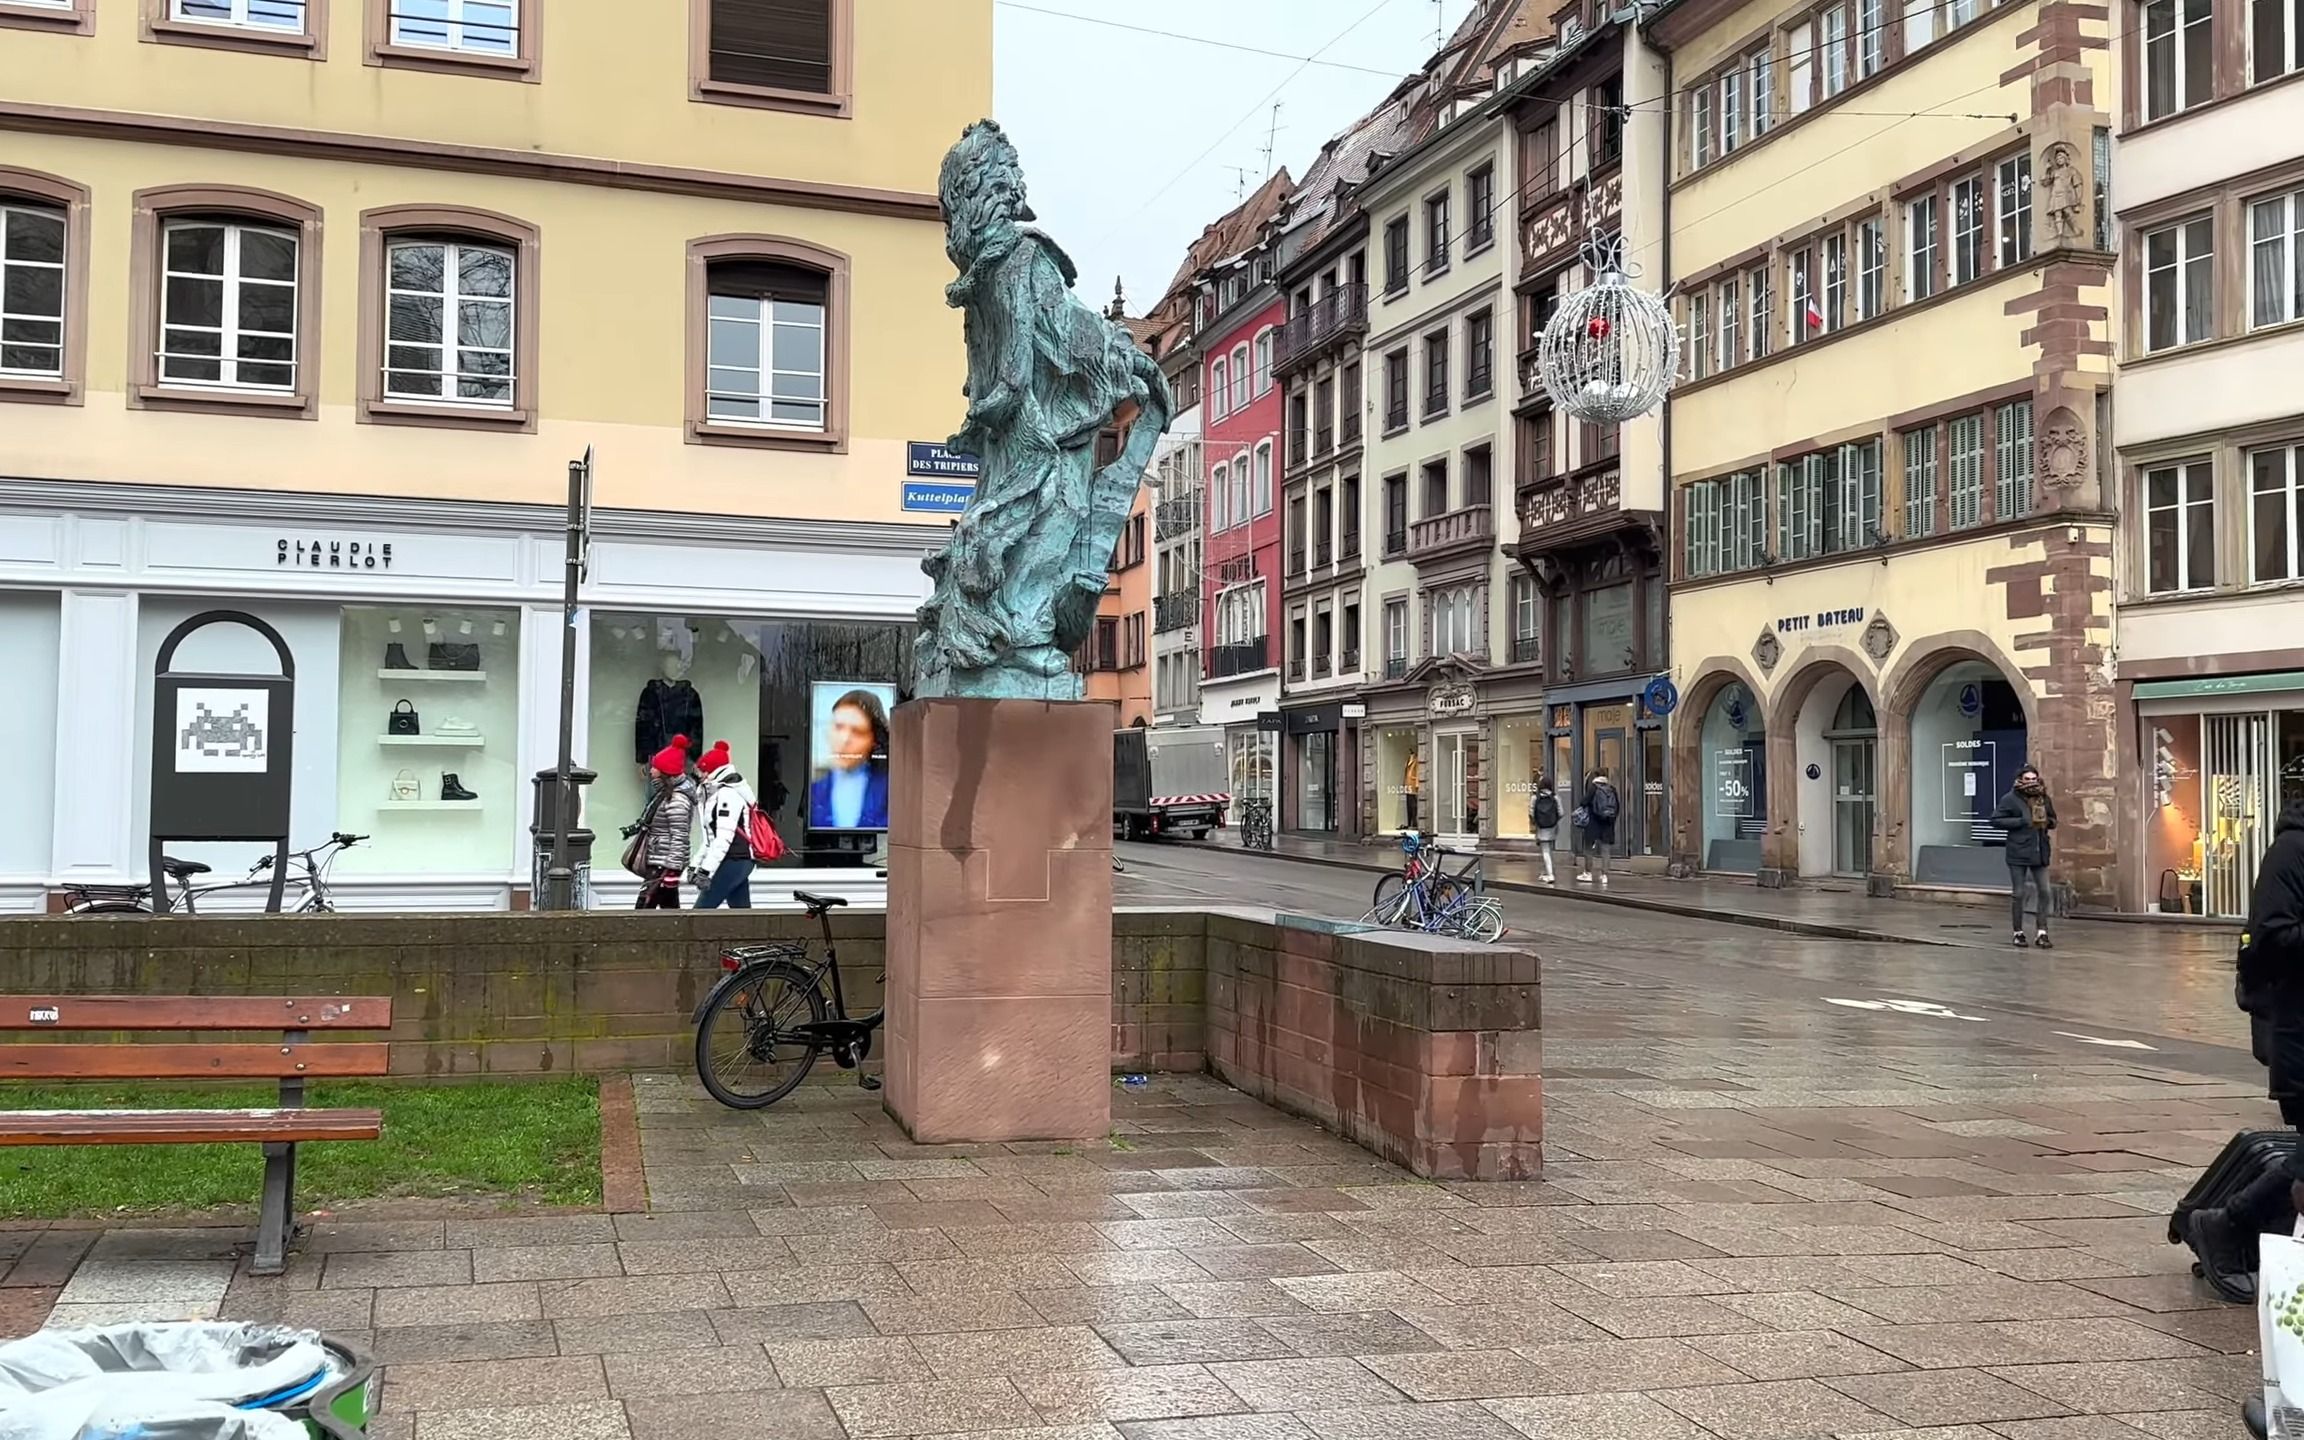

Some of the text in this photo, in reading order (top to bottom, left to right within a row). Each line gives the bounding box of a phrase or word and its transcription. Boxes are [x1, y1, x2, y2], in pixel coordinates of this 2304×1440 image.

[913, 459, 979, 472] DES TRIPIERS
[277, 539, 392, 556] CLAUDIE
[278, 553, 392, 569] PIERLOT
[1778, 607, 1864, 633] PETIT BATEAU
[1956, 740, 1981, 749] SOLDES
[1505, 782, 1538, 793] SOLDES
[1719, 779, 1749, 797] -50%
